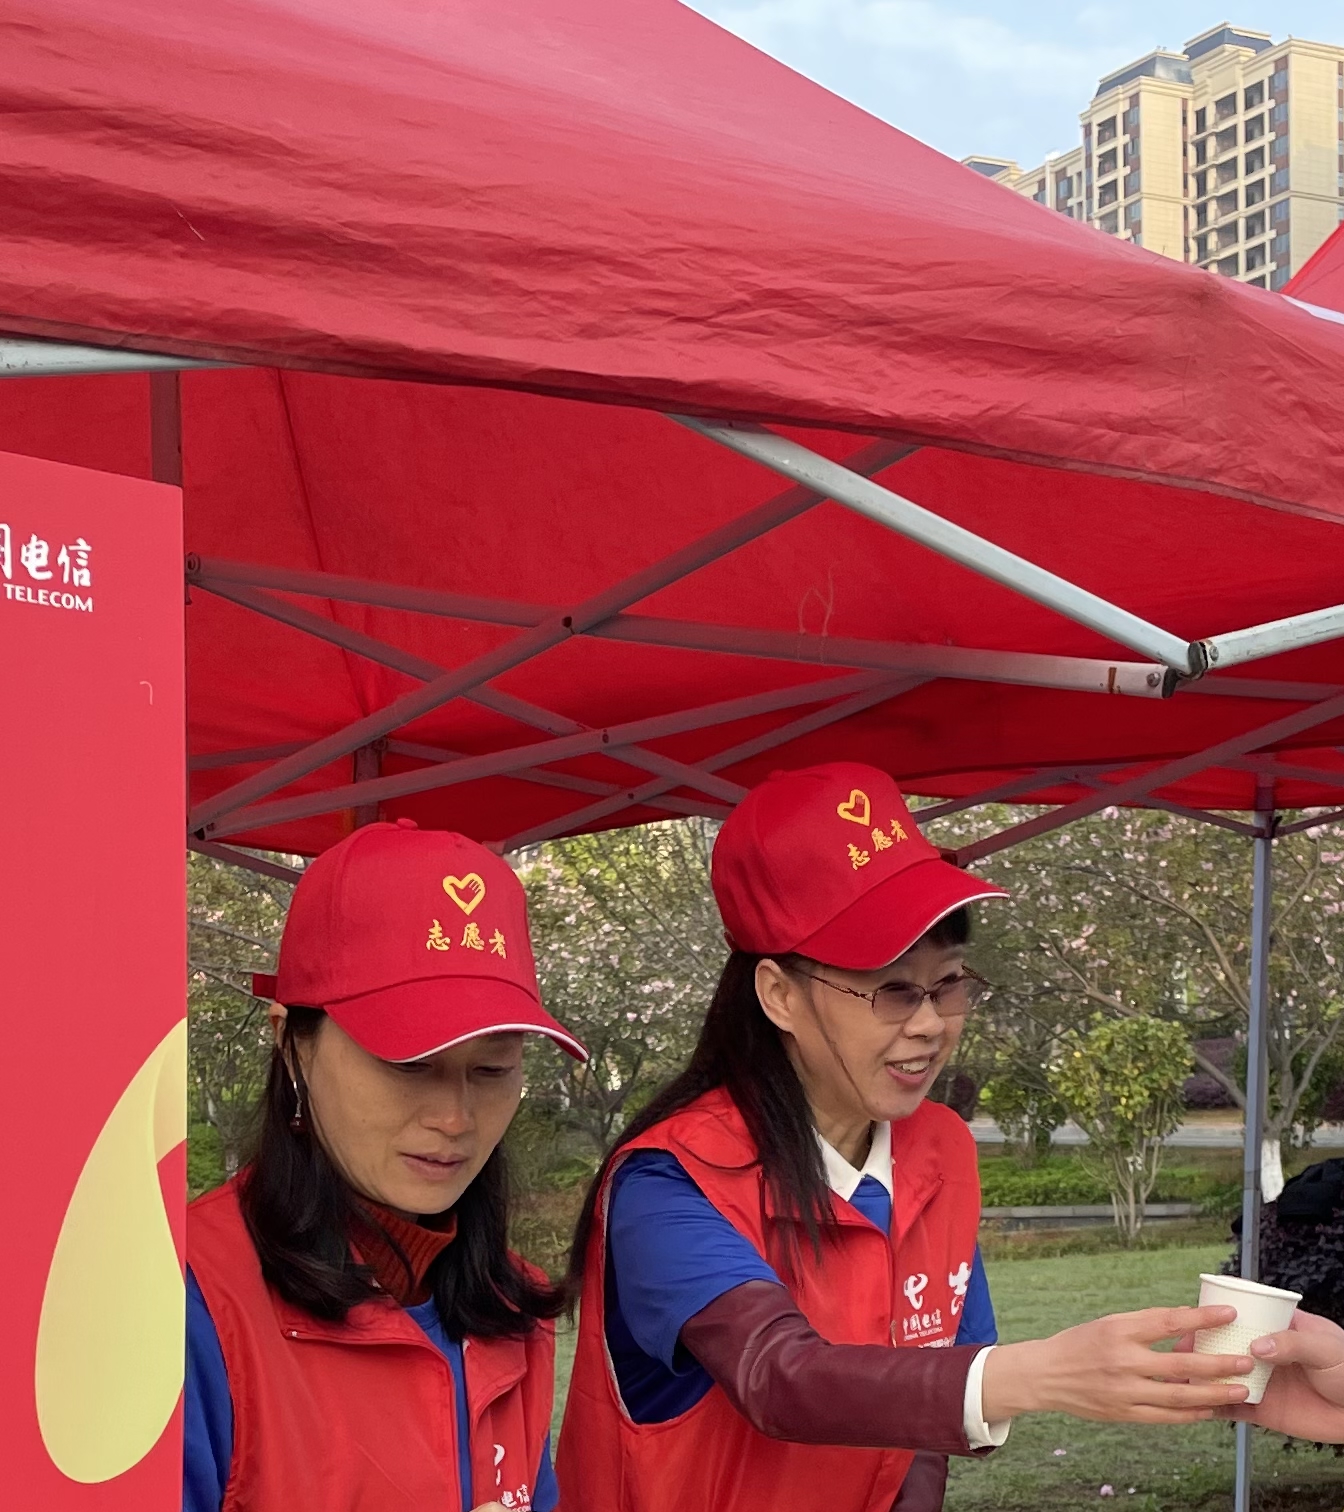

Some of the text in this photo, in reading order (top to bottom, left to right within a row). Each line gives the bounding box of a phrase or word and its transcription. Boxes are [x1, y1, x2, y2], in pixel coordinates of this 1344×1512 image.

[3, 582, 94, 612] TELECOM
[846, 819, 909, 871] 志愿者
[425, 918, 507, 960] 志愿者
